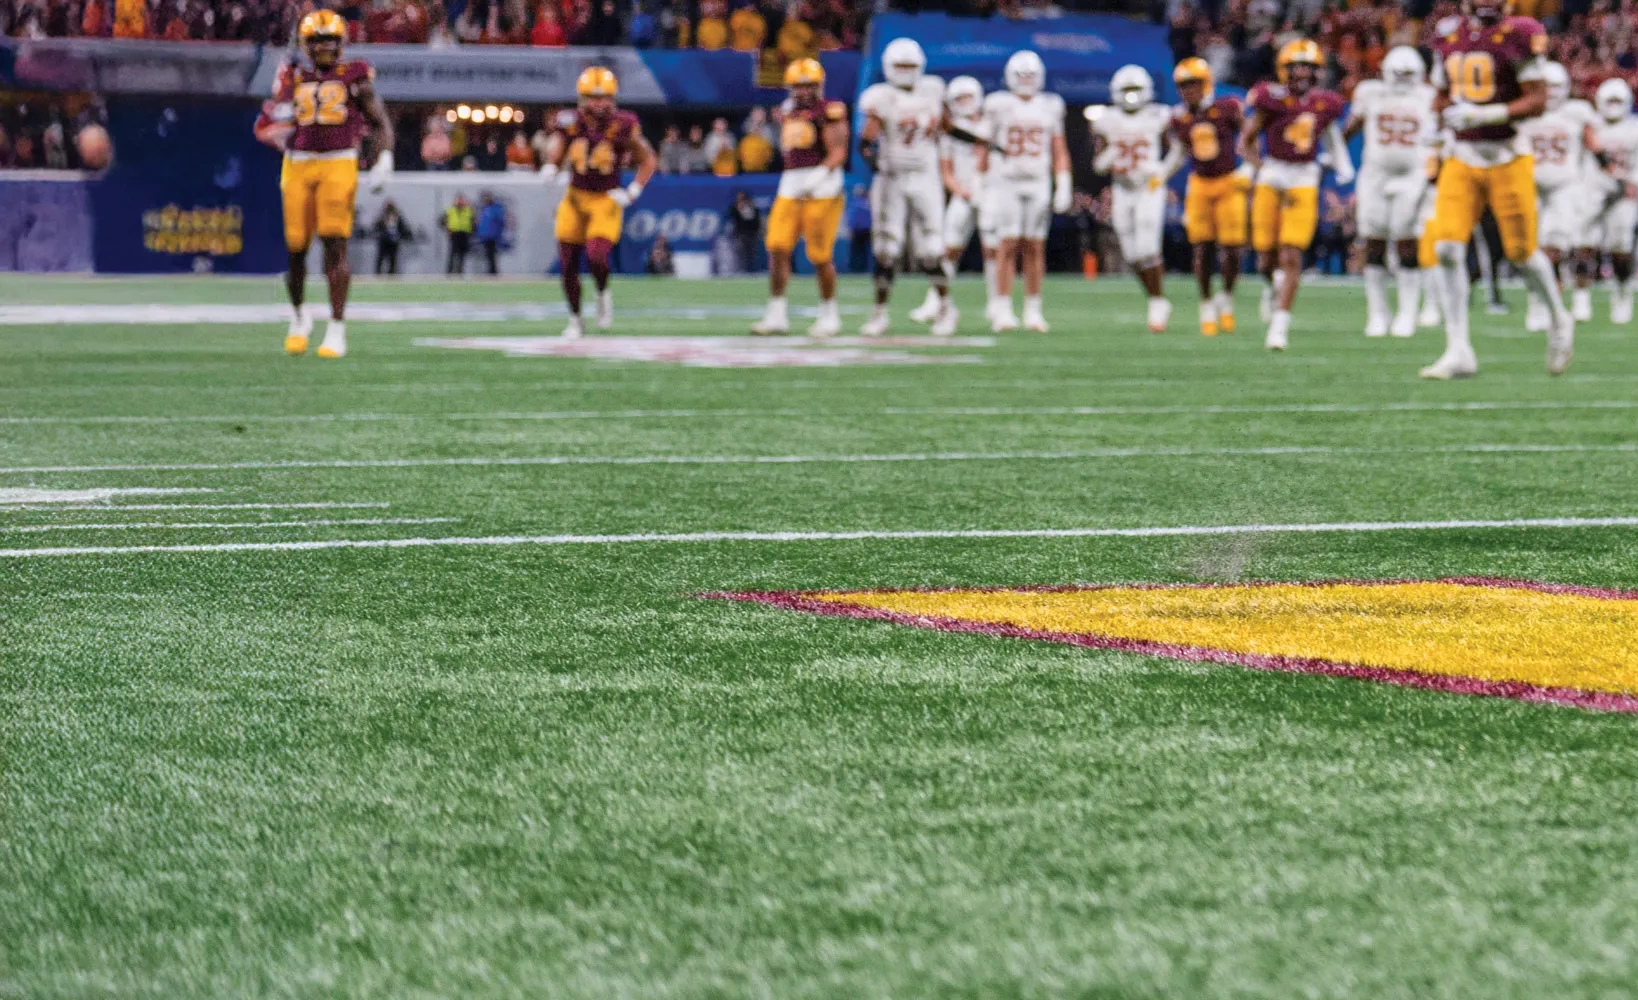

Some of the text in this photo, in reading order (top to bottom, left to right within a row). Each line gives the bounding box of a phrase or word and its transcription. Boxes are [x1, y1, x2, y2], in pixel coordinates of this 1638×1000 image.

[1446, 50, 1494, 102] 10
[1283, 111, 1317, 155] 4
[1376, 113, 1419, 147] 52
